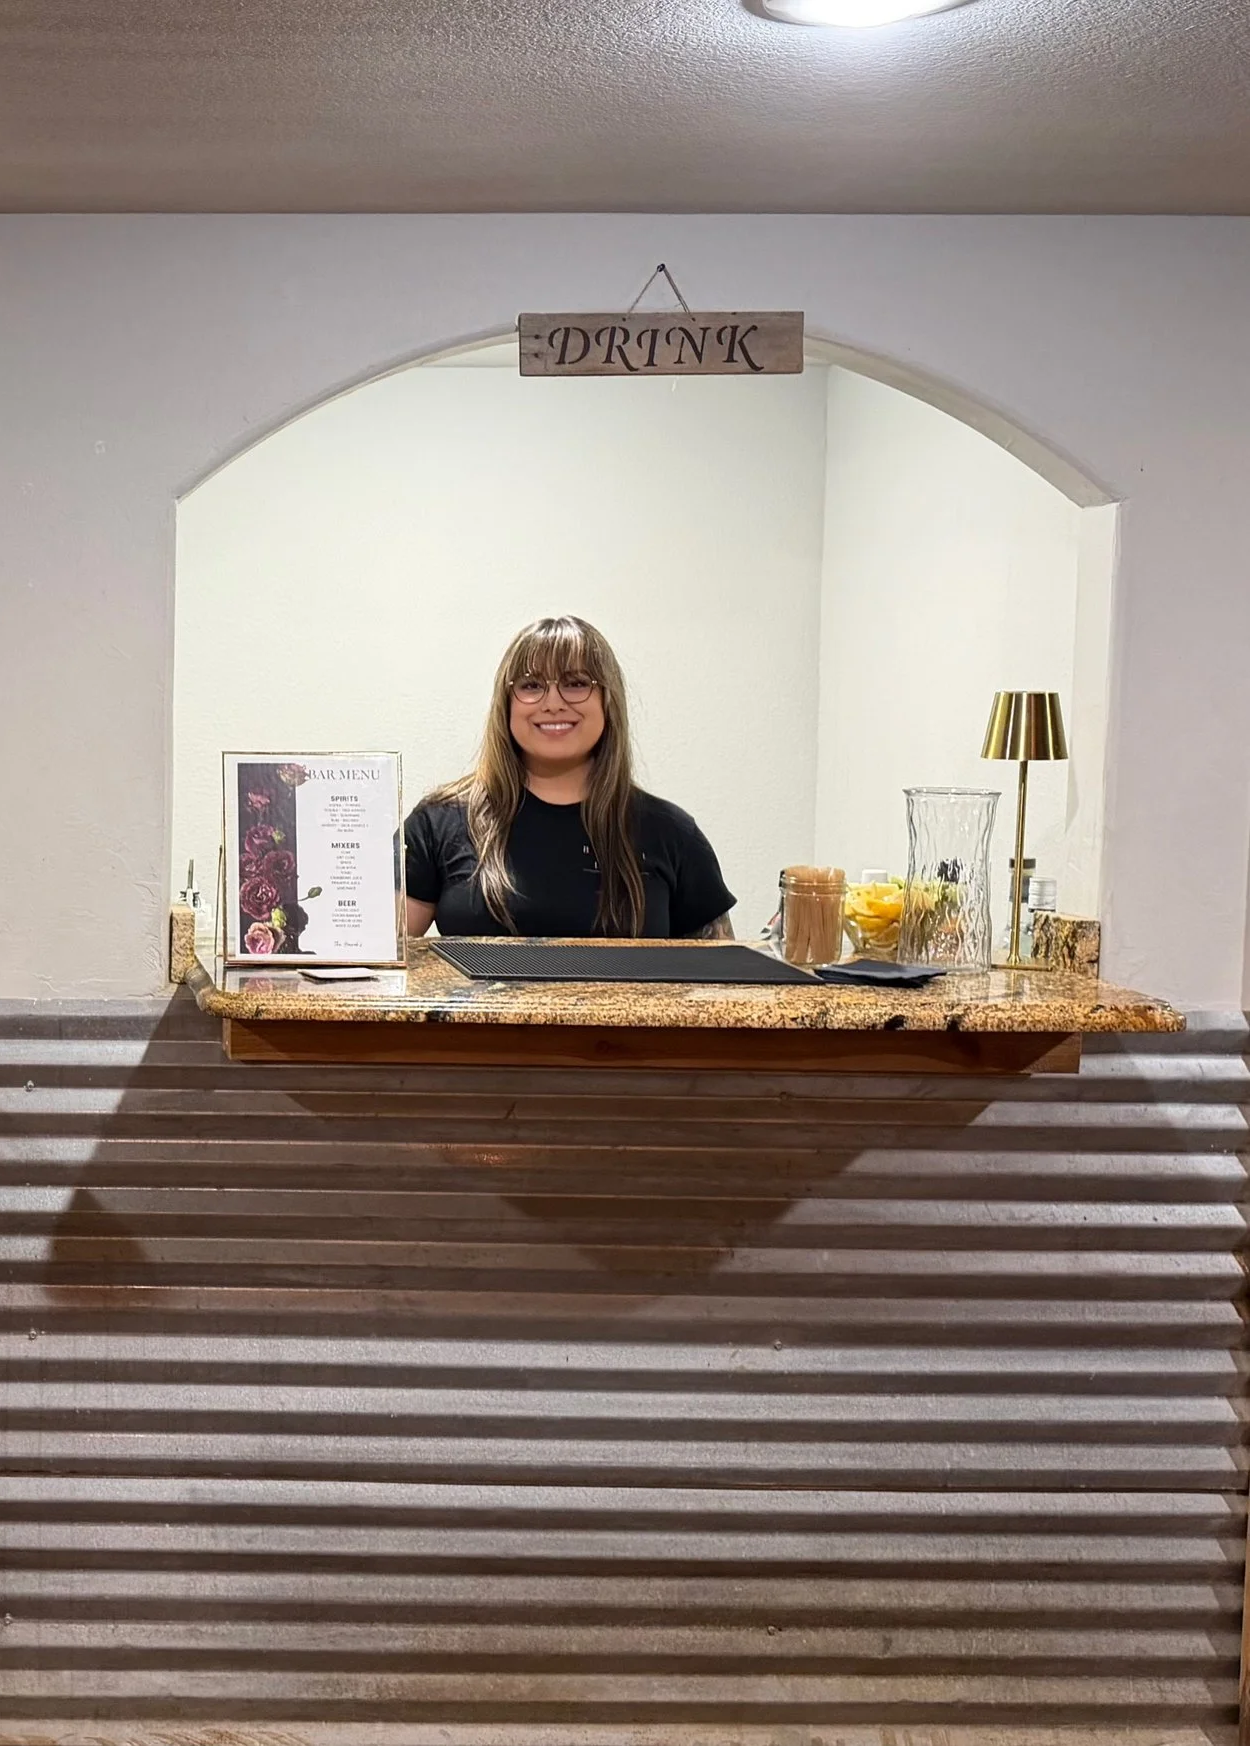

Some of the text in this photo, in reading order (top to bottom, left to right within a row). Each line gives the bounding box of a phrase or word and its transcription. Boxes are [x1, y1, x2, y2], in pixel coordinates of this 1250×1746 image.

[548, 325, 765, 372] DRINK
[309, 769, 380, 780] BAR MENU
[338, 899, 357, 907] BEER
